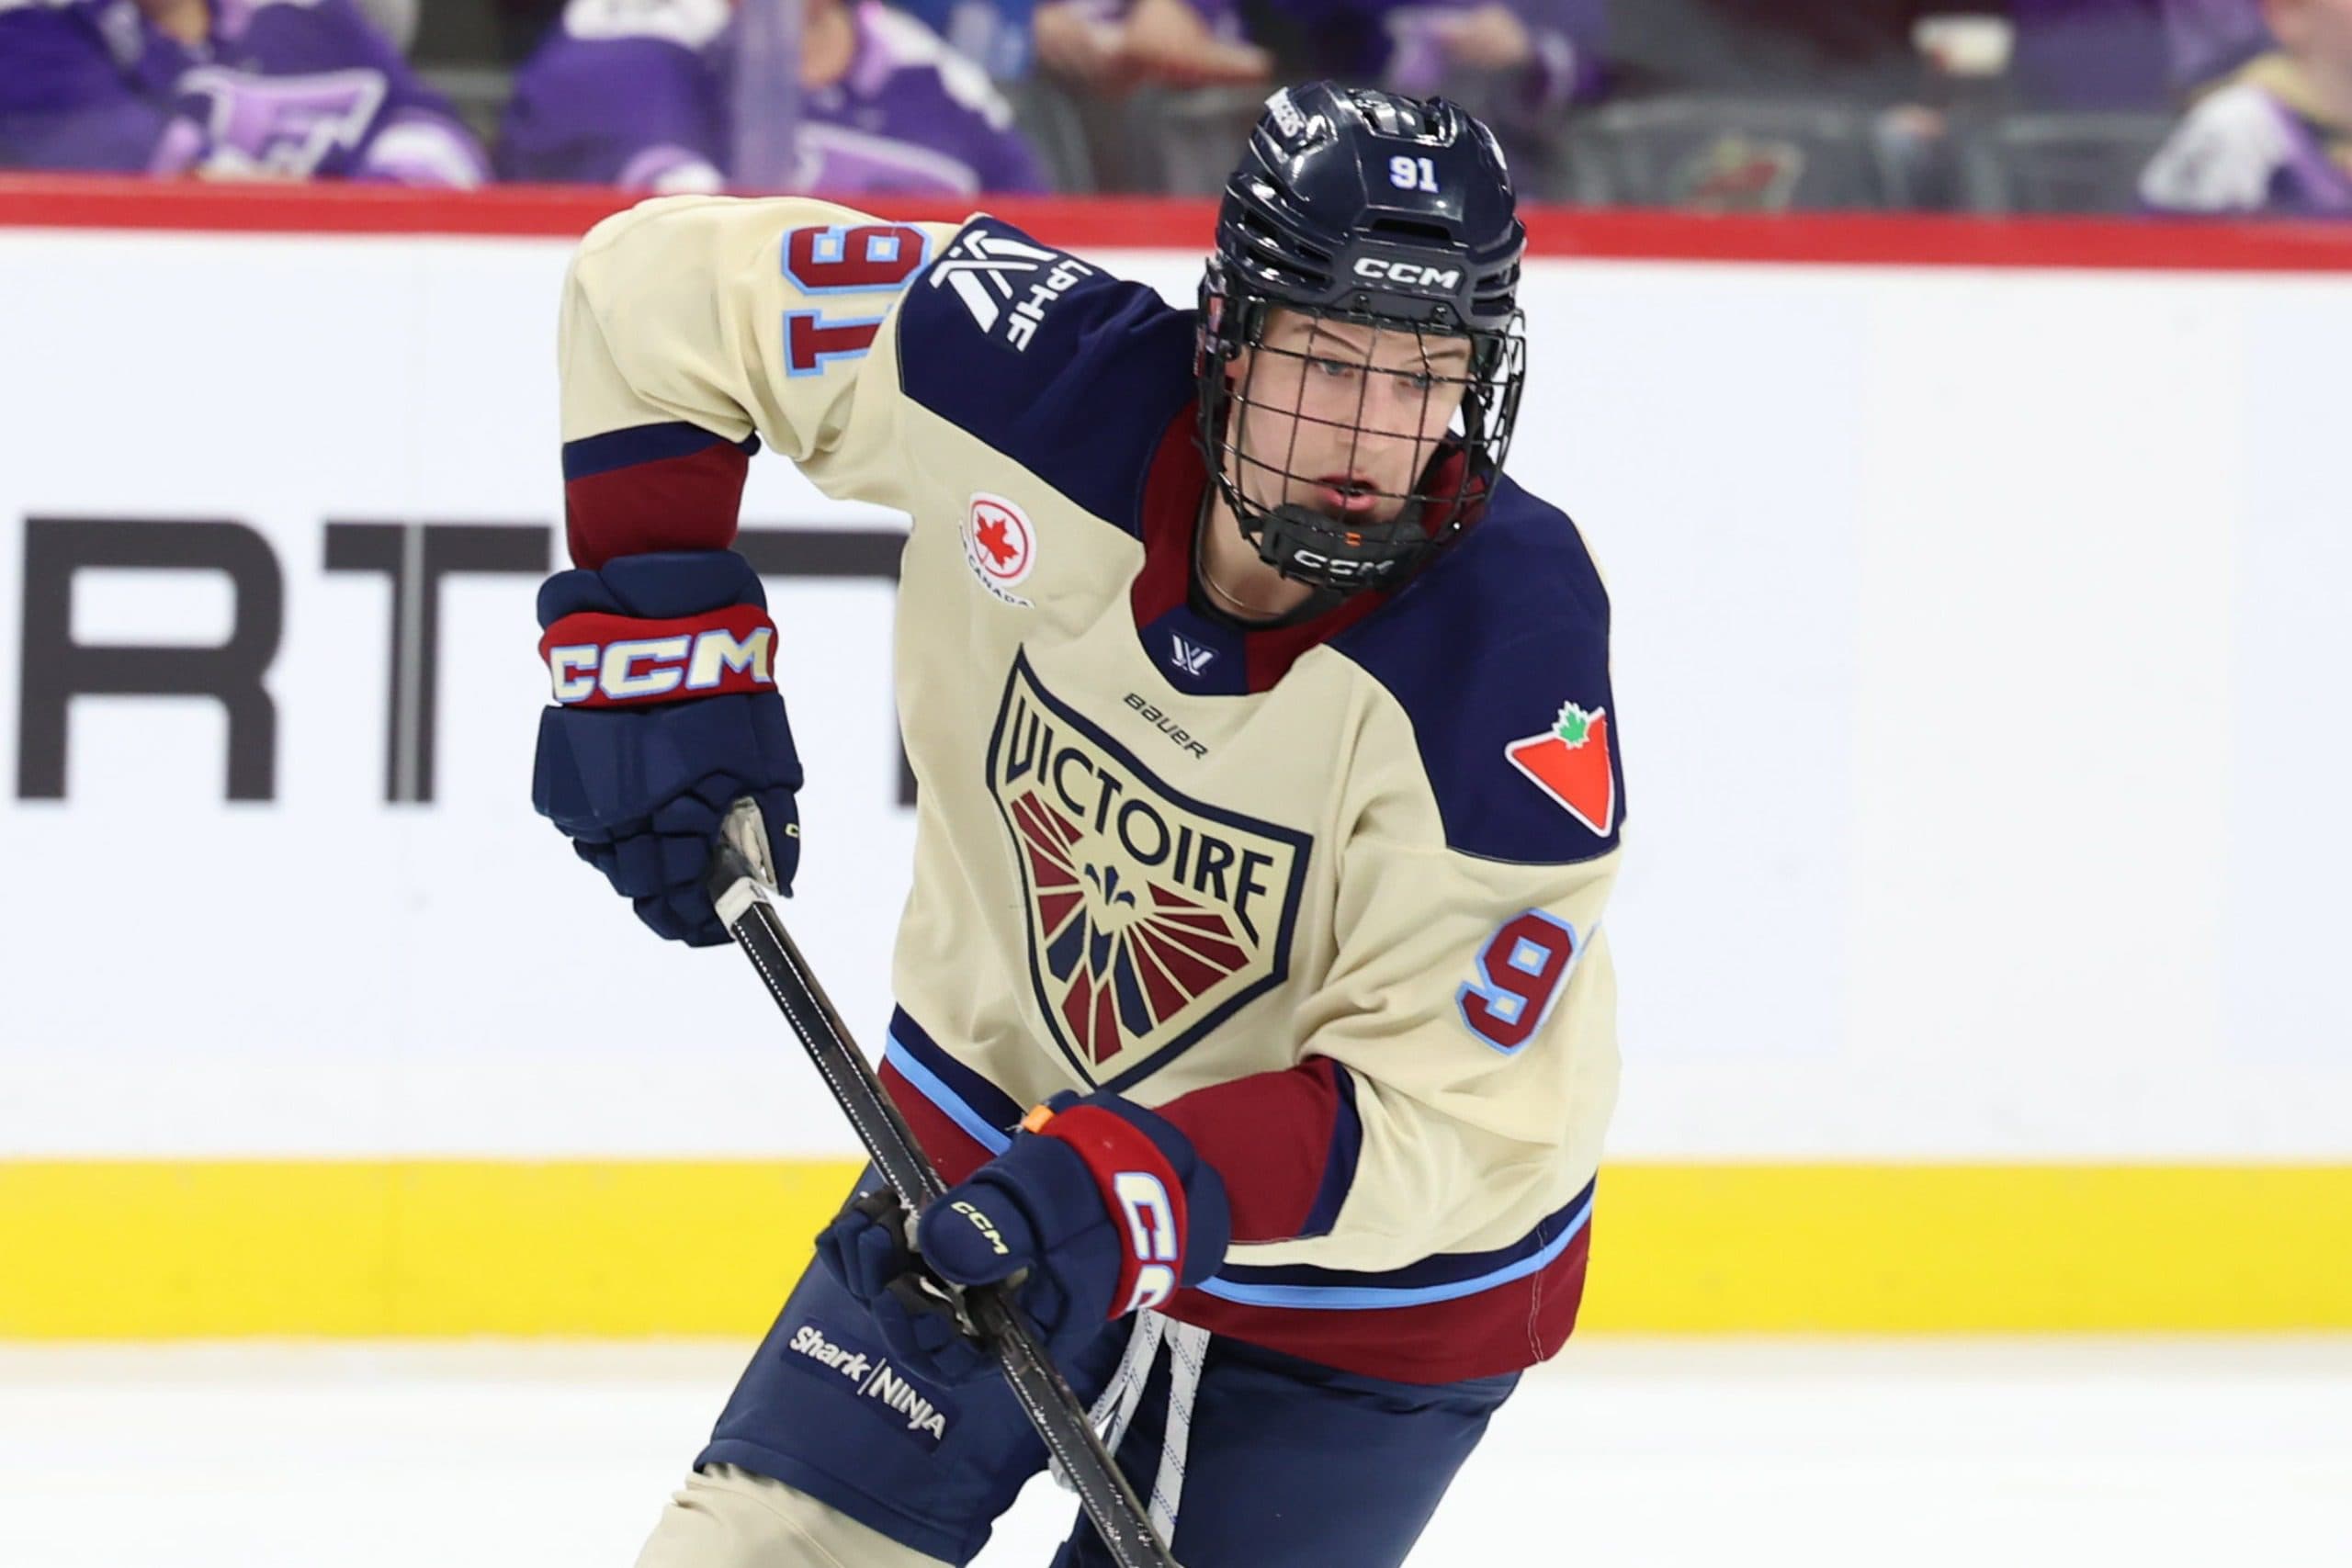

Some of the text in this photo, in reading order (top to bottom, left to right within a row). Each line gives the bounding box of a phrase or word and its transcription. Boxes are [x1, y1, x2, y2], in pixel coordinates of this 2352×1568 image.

[1388, 155, 1439, 194] 91
[781, 221, 933, 377] 91
[1006, 259, 1094, 352] LPHF
[1352, 256, 1462, 290] CCM
[549, 626, 774, 703] CCM
[1005, 694, 1274, 950] VICTOIRE
[1454, 906, 1601, 1056] 9
[951, 1201, 1009, 1255] CCM
[789, 1325, 946, 1440] Shark NINJA
